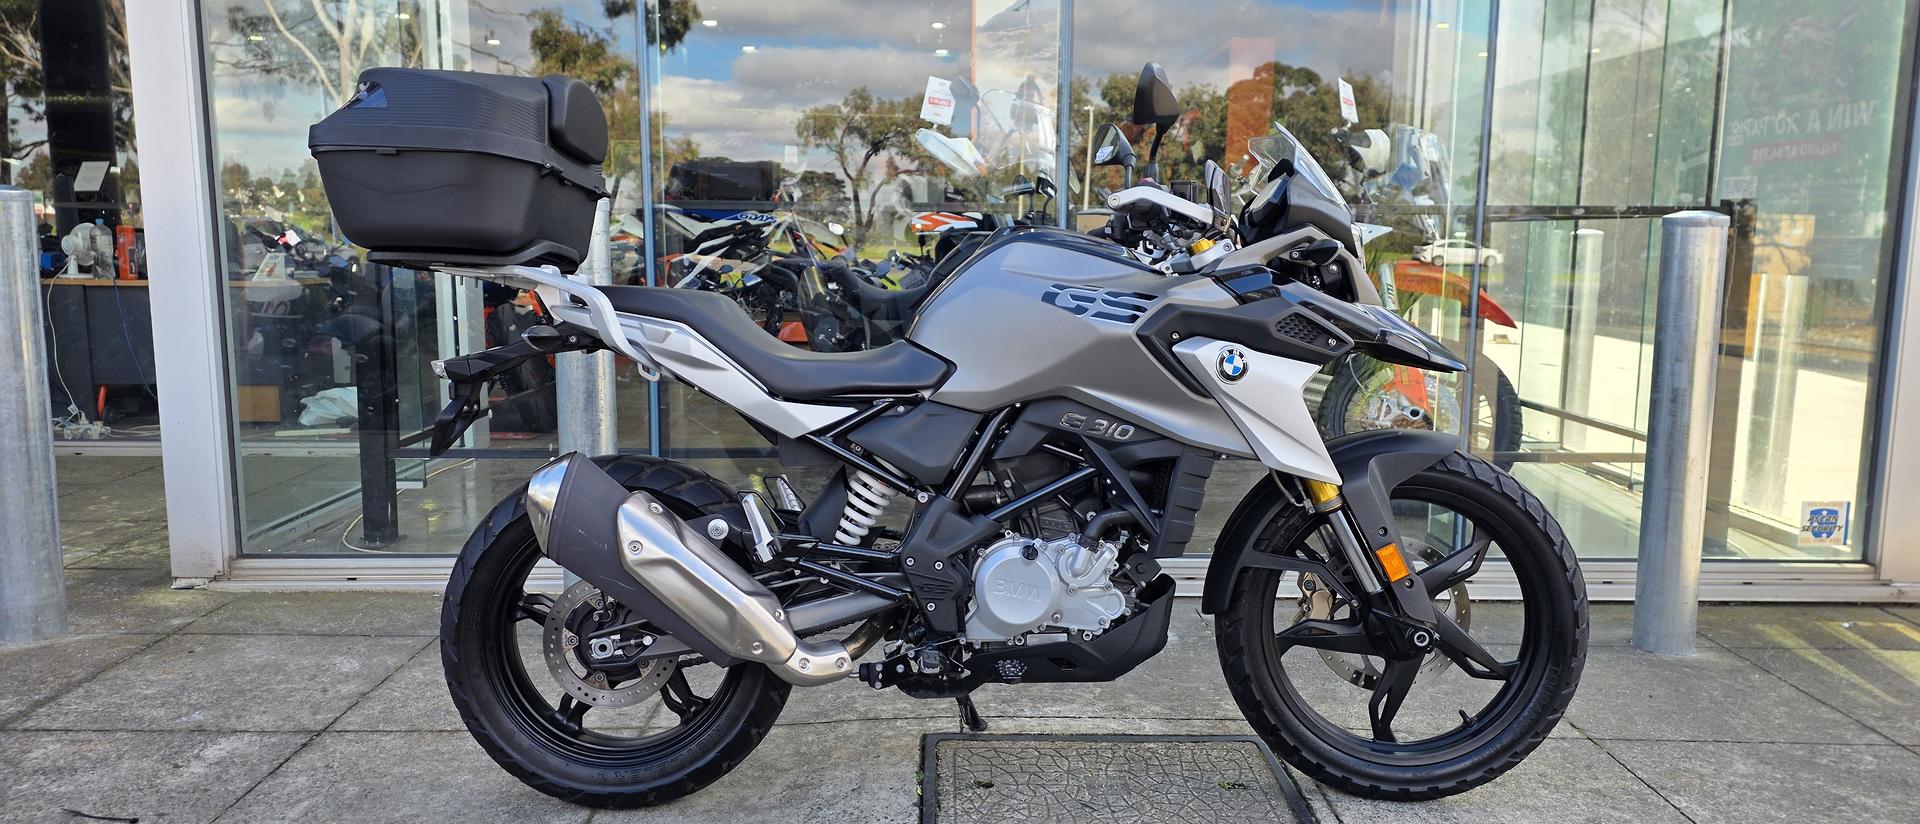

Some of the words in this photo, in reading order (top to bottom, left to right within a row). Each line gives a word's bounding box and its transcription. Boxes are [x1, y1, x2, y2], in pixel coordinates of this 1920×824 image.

[1041, 283, 1159, 325] GS
[1060, 412, 1087, 431] G
[1086, 419, 1136, 440] 310
[992, 577, 1048, 602] BMW
